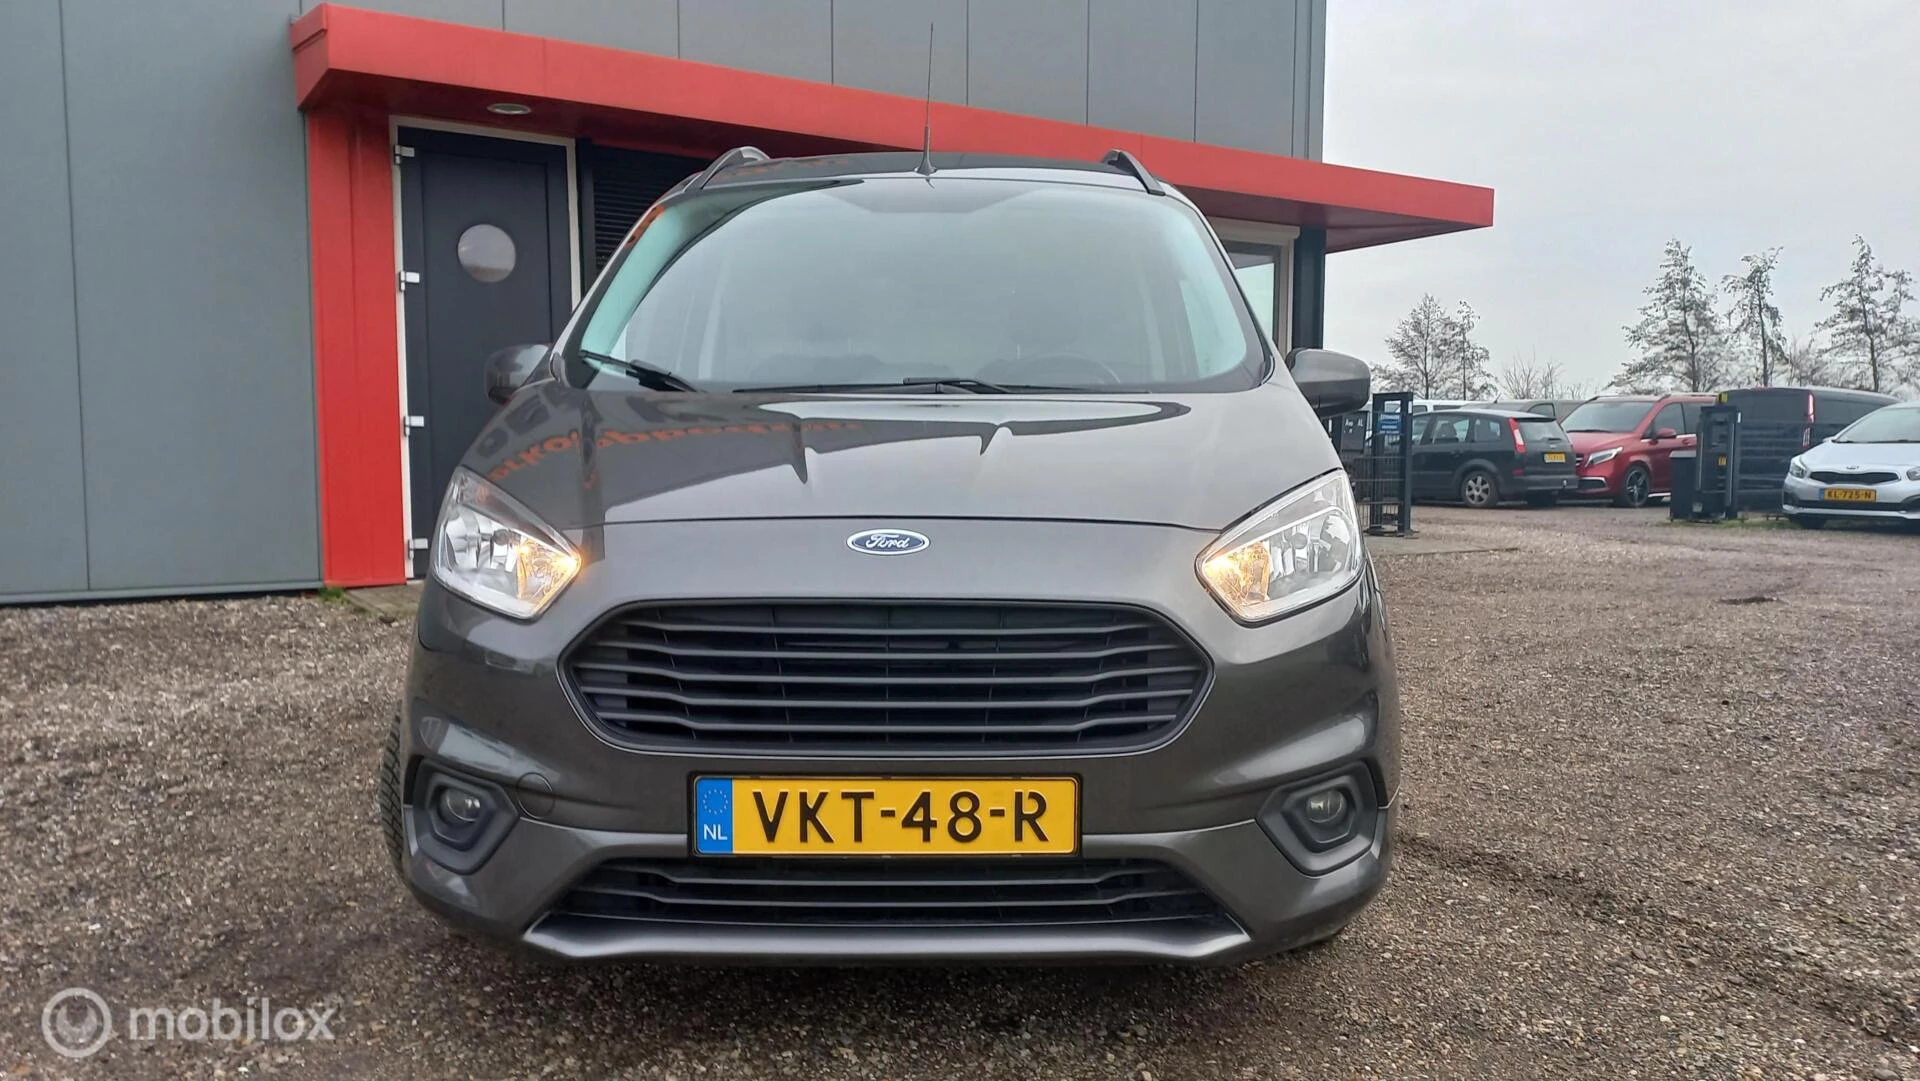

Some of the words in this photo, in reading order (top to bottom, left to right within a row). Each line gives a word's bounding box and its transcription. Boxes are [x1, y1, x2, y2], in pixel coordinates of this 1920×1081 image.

[865, 533, 910, 549] Ford
[751, 789, 1050, 843] VKT-48-R
[702, 823, 729, 841] NL
